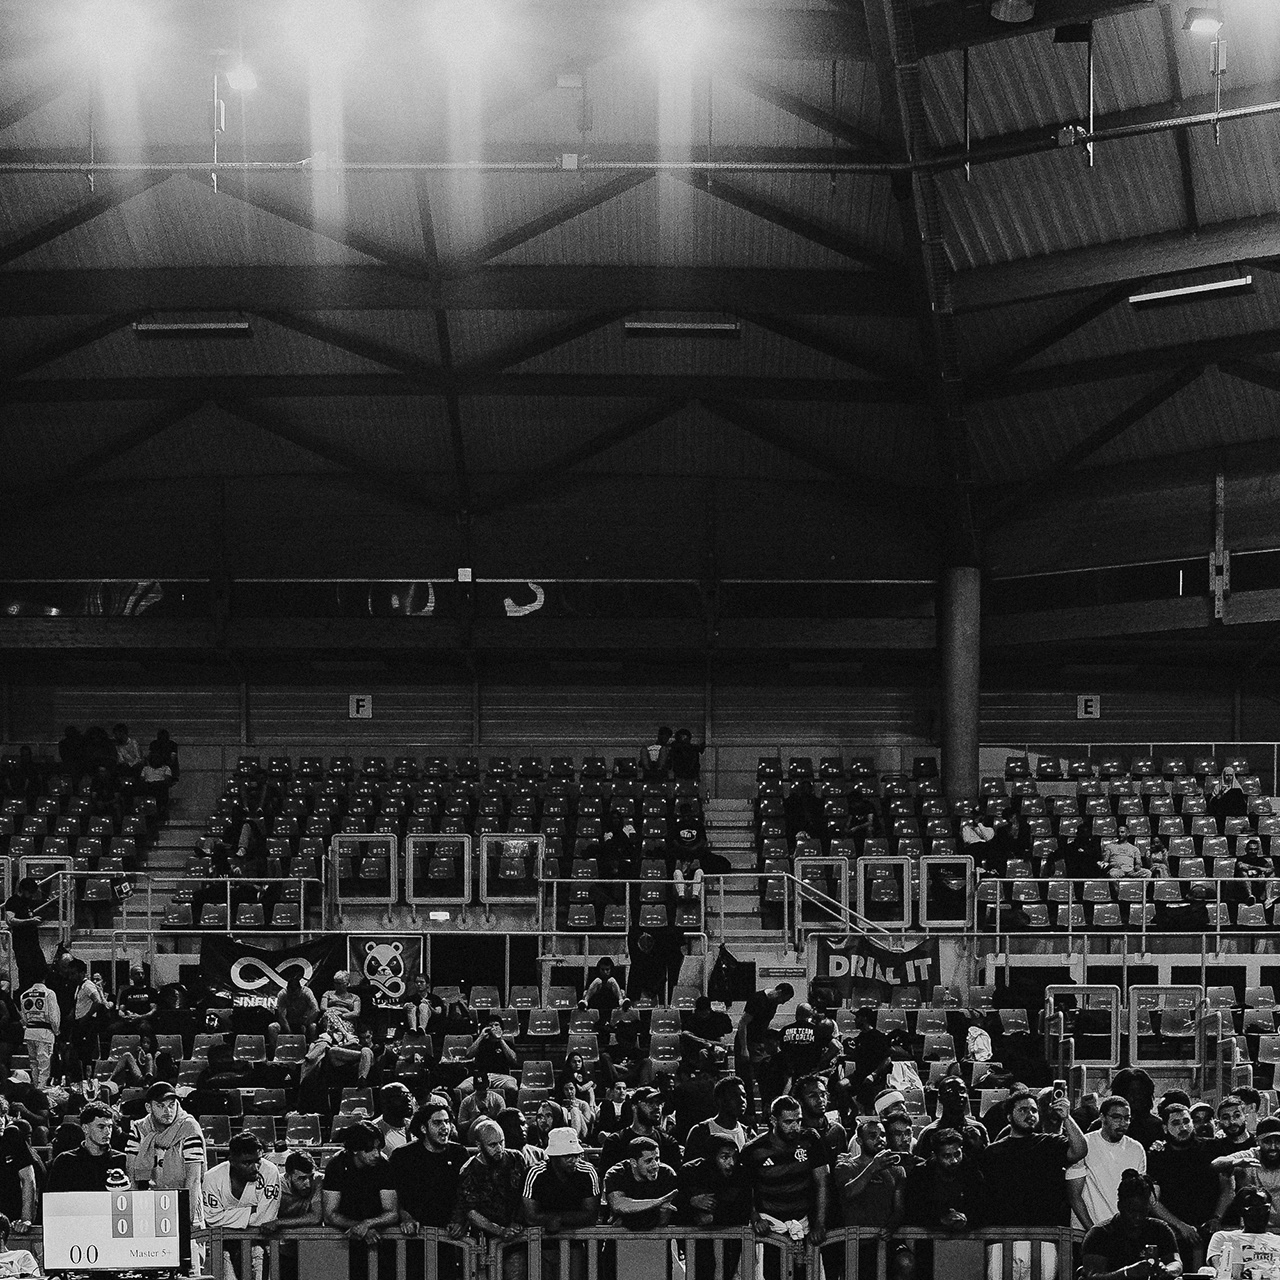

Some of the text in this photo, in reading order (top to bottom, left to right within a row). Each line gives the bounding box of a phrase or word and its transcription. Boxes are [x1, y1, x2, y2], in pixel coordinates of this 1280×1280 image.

[355, 698, 366, 714] F
[1083, 698, 1094, 715] E
[905, 957, 932, 983] IT
[116, 1195, 127, 1211] 0
[160, 1194, 170, 1211] 0
[117, 1218, 128, 1235] 0
[160, 1217, 171, 1234] 0
[129, 1249, 159, 1258] Master
